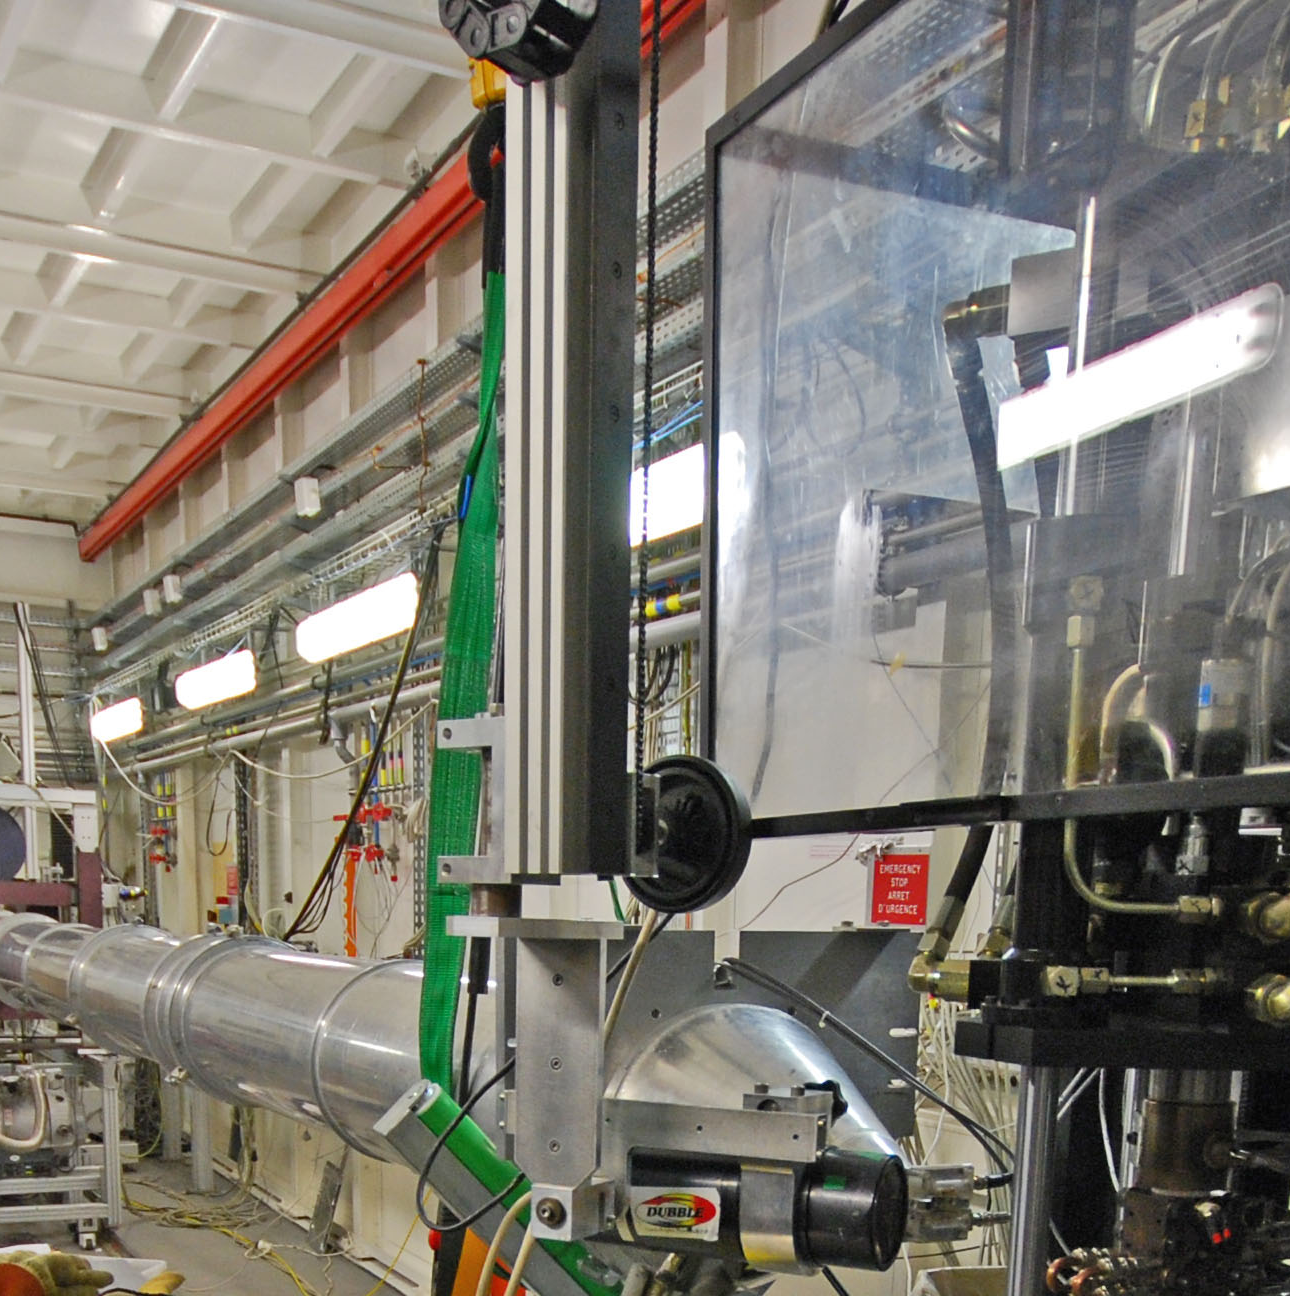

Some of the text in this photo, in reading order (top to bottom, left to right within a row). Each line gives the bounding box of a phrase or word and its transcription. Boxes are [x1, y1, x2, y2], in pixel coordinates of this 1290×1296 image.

[879, 864, 922, 875] EMERGENCY
[890, 877, 909, 888] STOP
[887, 890, 910, 901] ARRET
[646, 1206, 706, 1218] DUBBLE
